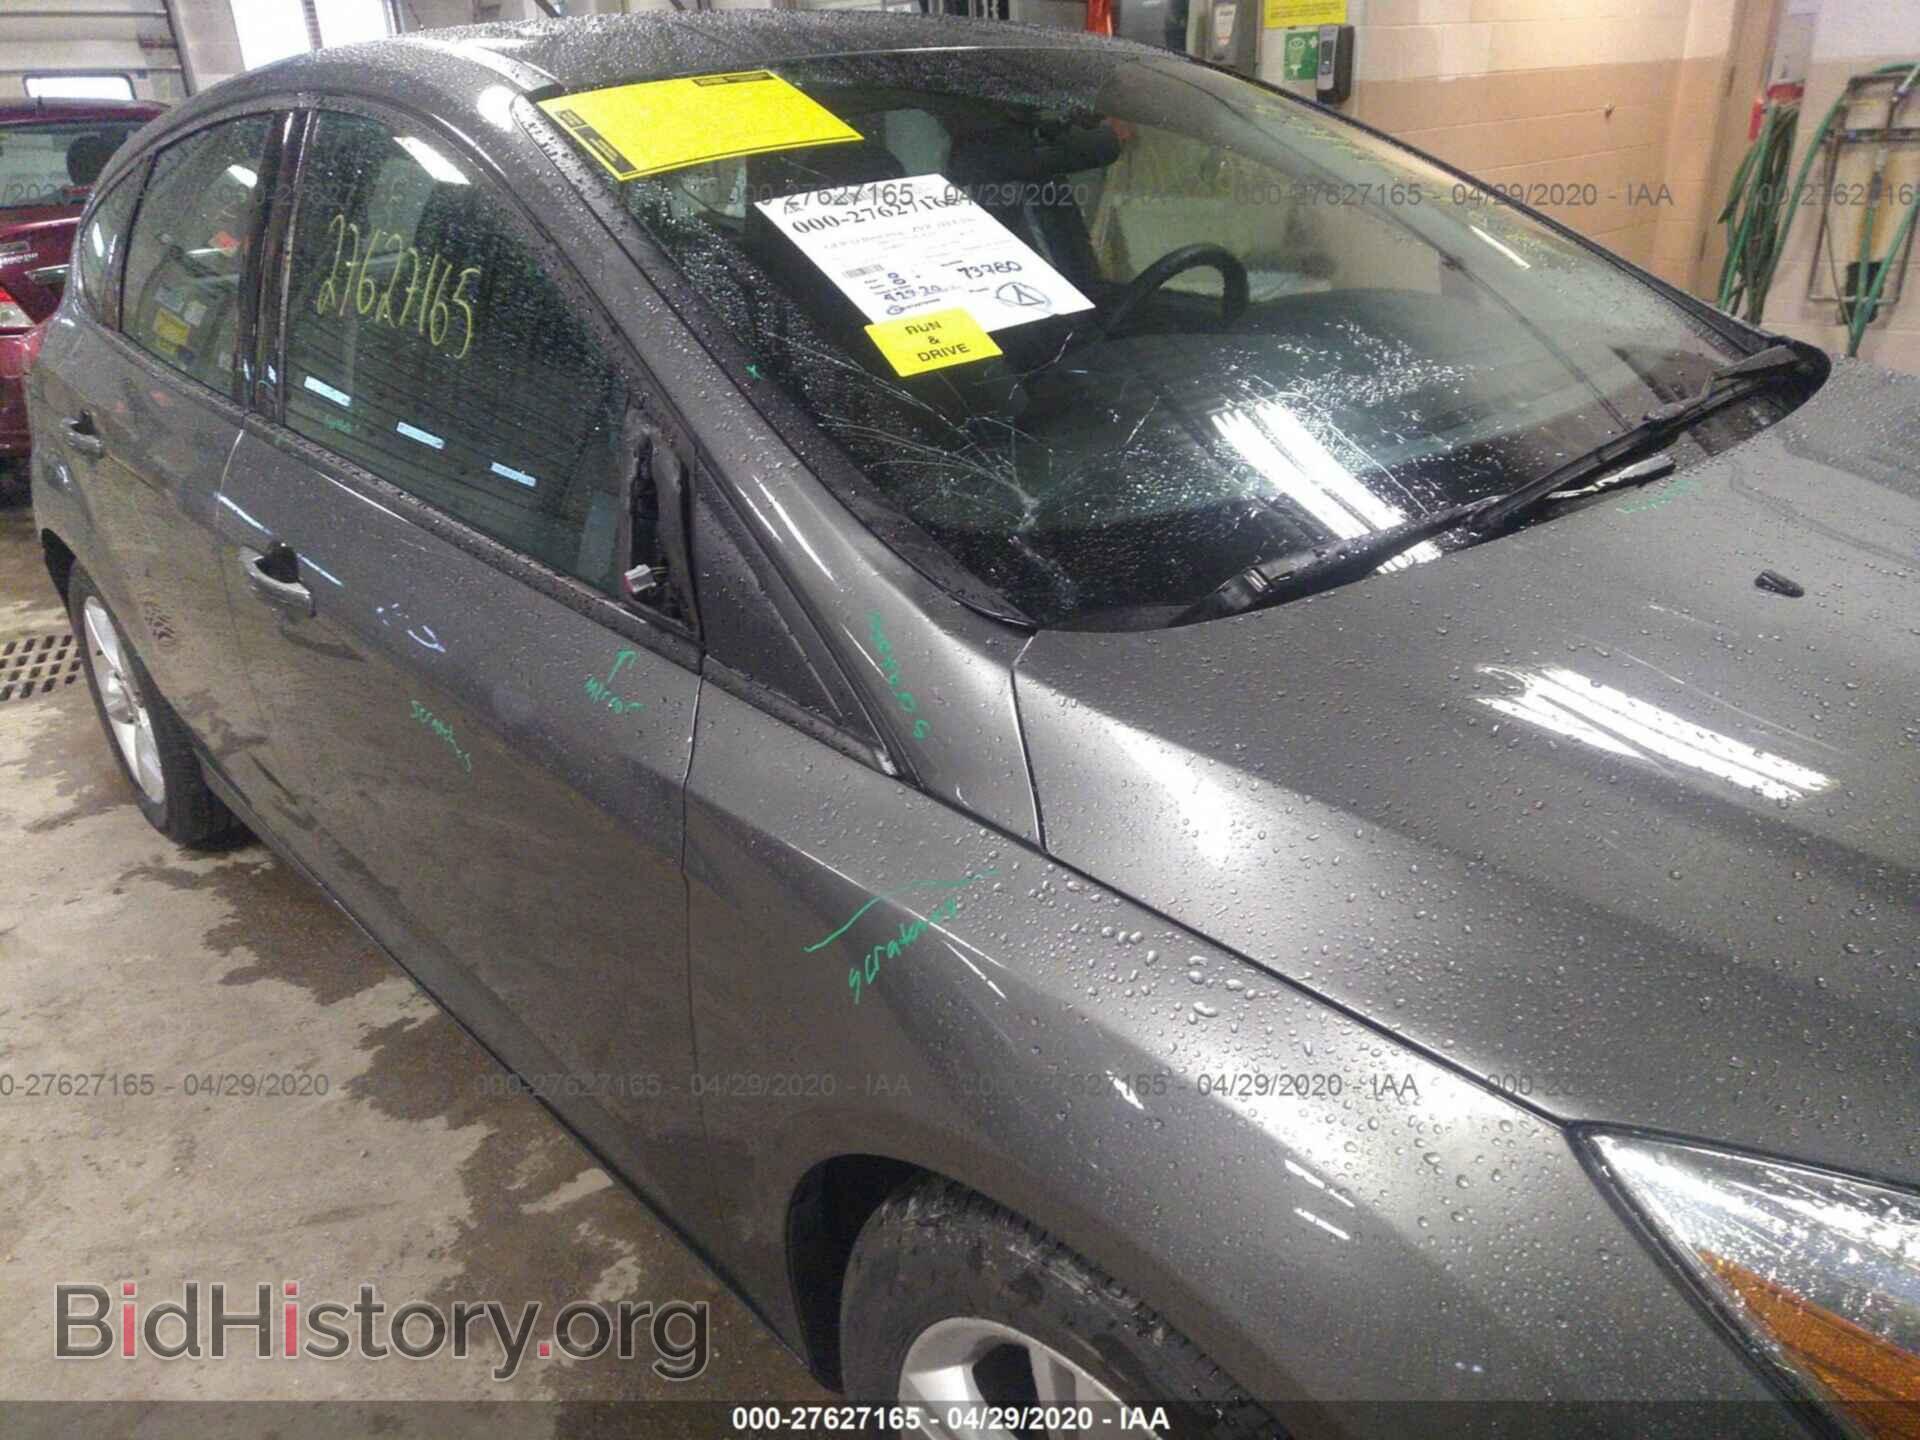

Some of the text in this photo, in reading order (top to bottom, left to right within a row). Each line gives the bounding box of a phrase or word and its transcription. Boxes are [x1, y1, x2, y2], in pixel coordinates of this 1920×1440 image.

[317, 214, 480, 360] 27627165
[904, 320, 942, 335] RUN
[928, 335, 941, 345] &
[917, 343, 971, 363] DRIVE
